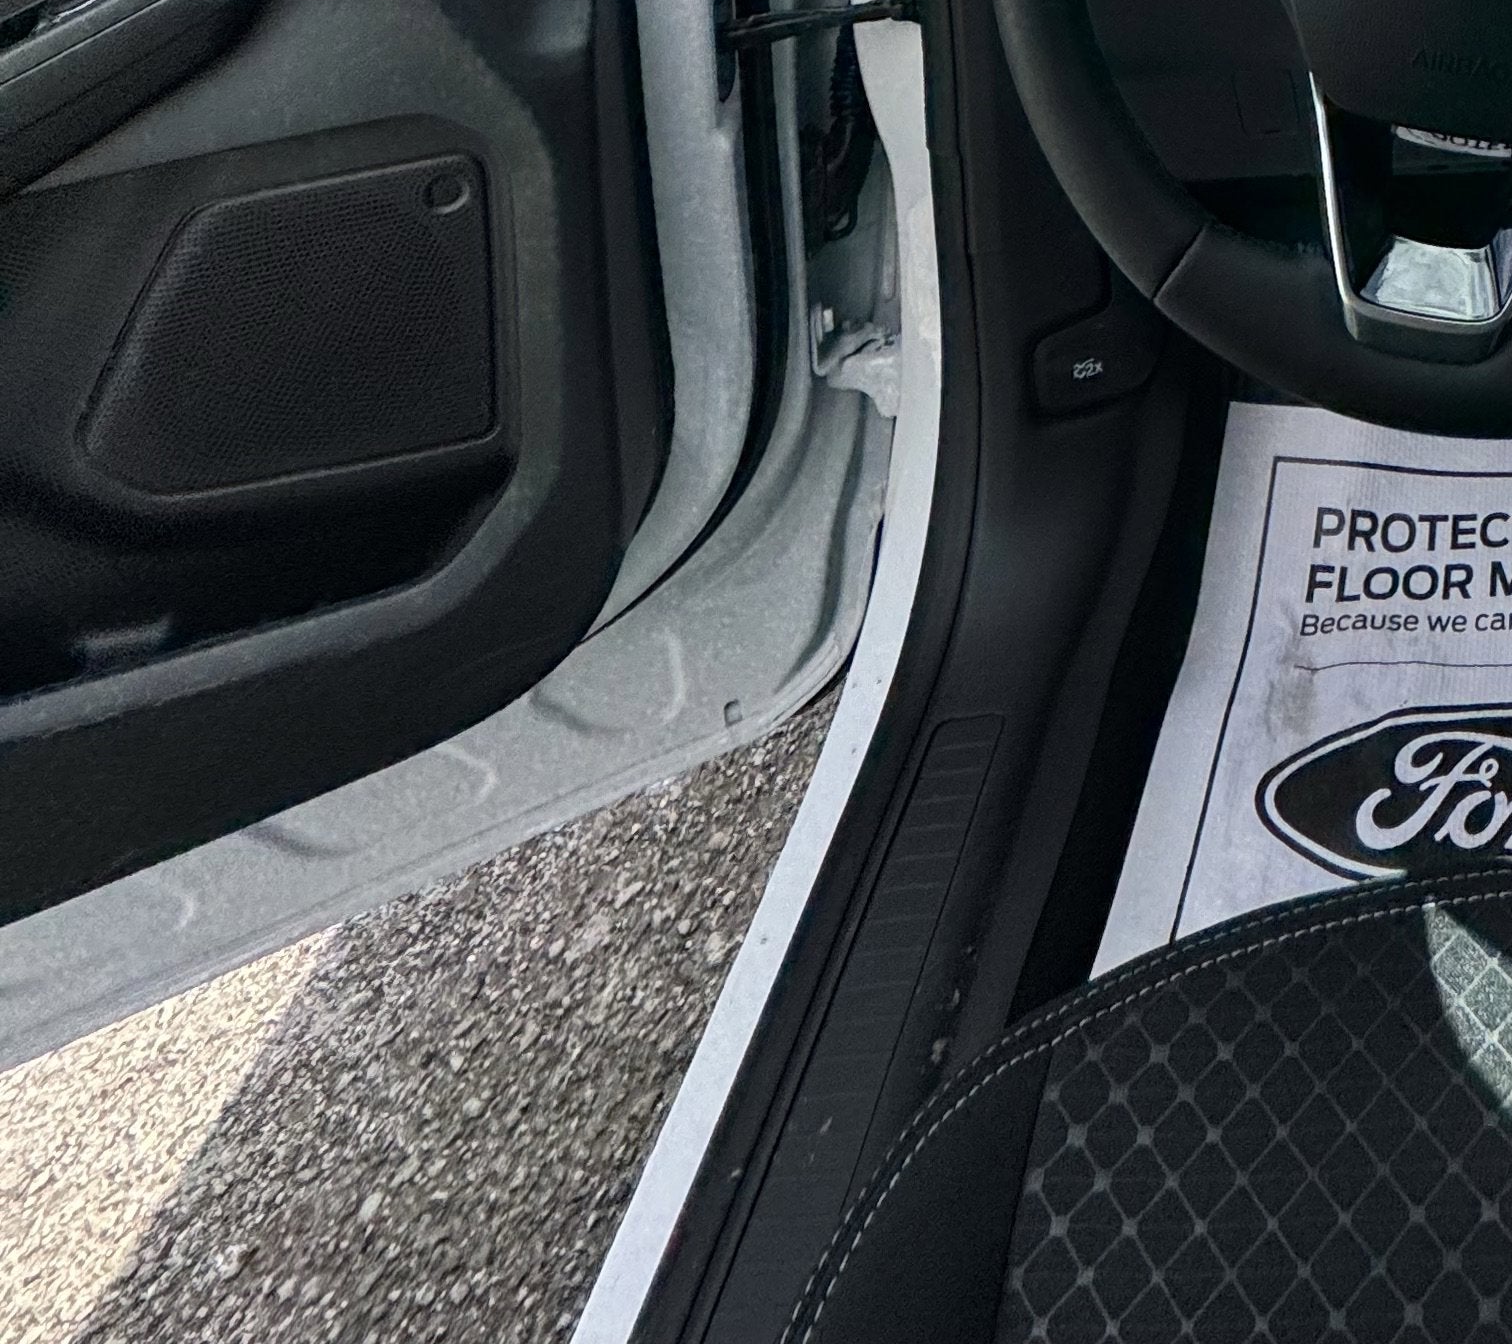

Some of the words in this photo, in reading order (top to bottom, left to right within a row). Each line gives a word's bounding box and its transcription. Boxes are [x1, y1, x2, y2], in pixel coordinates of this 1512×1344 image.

[1305, 561, 1473, 604] FLOOR
[1299, 612, 1420, 637] Because
[1426, 613, 1468, 633] we
